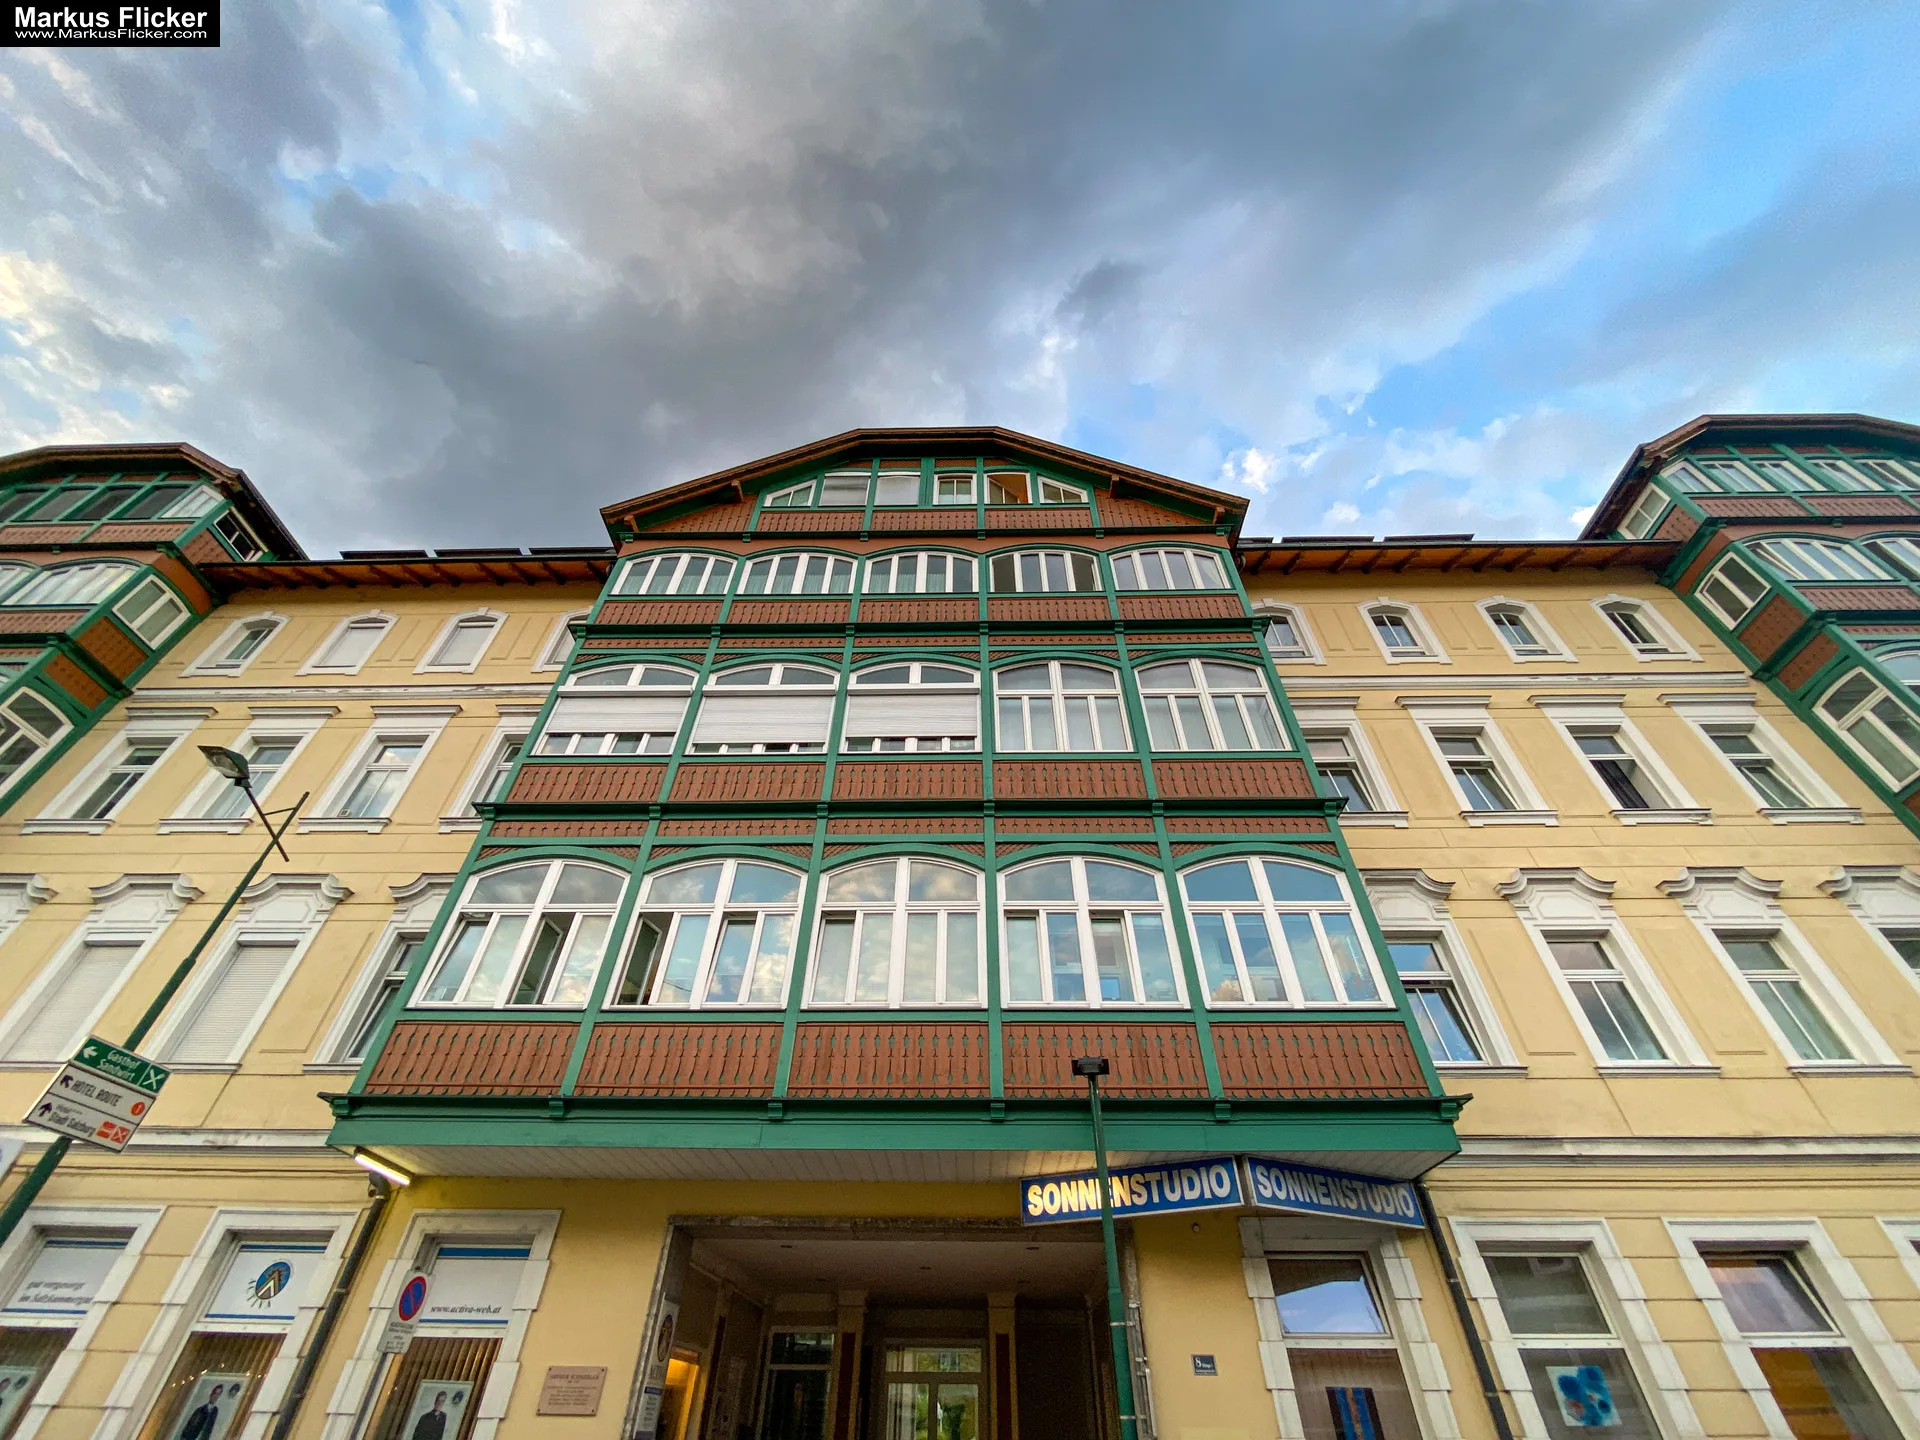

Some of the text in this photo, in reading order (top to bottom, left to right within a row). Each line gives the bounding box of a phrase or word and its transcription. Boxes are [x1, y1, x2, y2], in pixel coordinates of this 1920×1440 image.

[97, 1059, 136, 1082] Sandwirt
[107, 1050, 141, 1070] Gasthof
[71, 1080, 122, 1107] HOTEL ROUTE
[48, 1111, 97, 1138] Stadt Salzburg
[1255, 1164, 1415, 1218] SONNENSTUDIO
